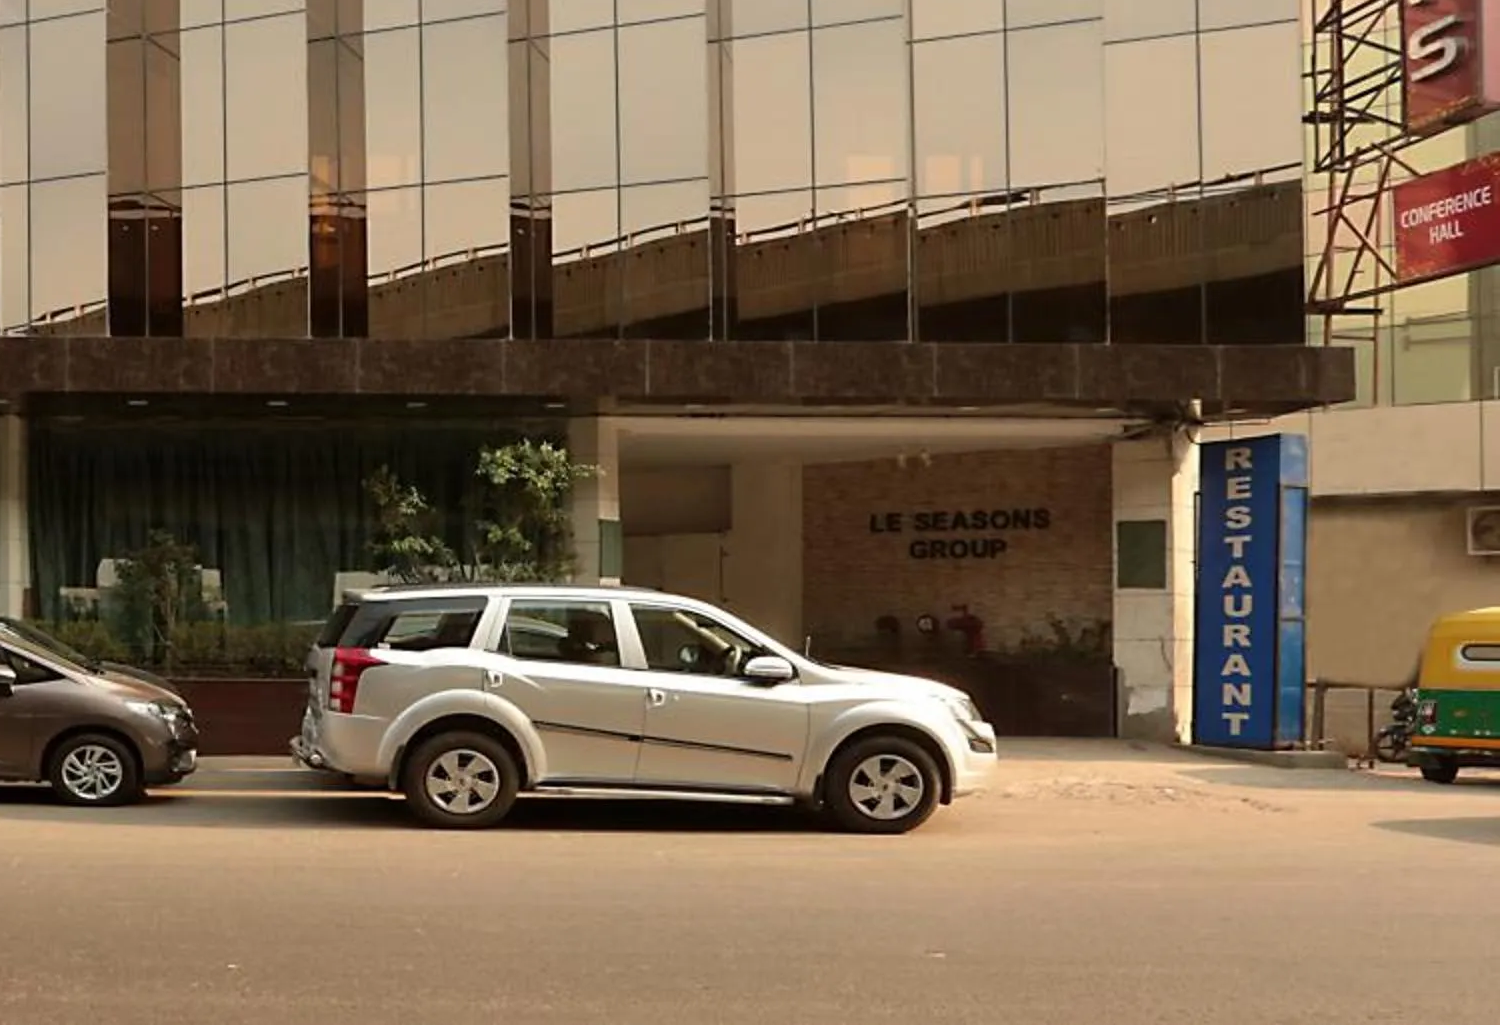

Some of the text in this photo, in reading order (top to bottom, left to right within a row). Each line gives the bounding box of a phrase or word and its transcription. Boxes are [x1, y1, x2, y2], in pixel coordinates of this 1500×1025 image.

[1401, 185, 1492, 229] CONFERENCE
[1429, 220, 1465, 245] HALL
[869, 508, 1052, 533] LE SEASONS
[909, 538, 1008, 560] GROUP
[1221, 447, 1252, 736] RESTAURANT
